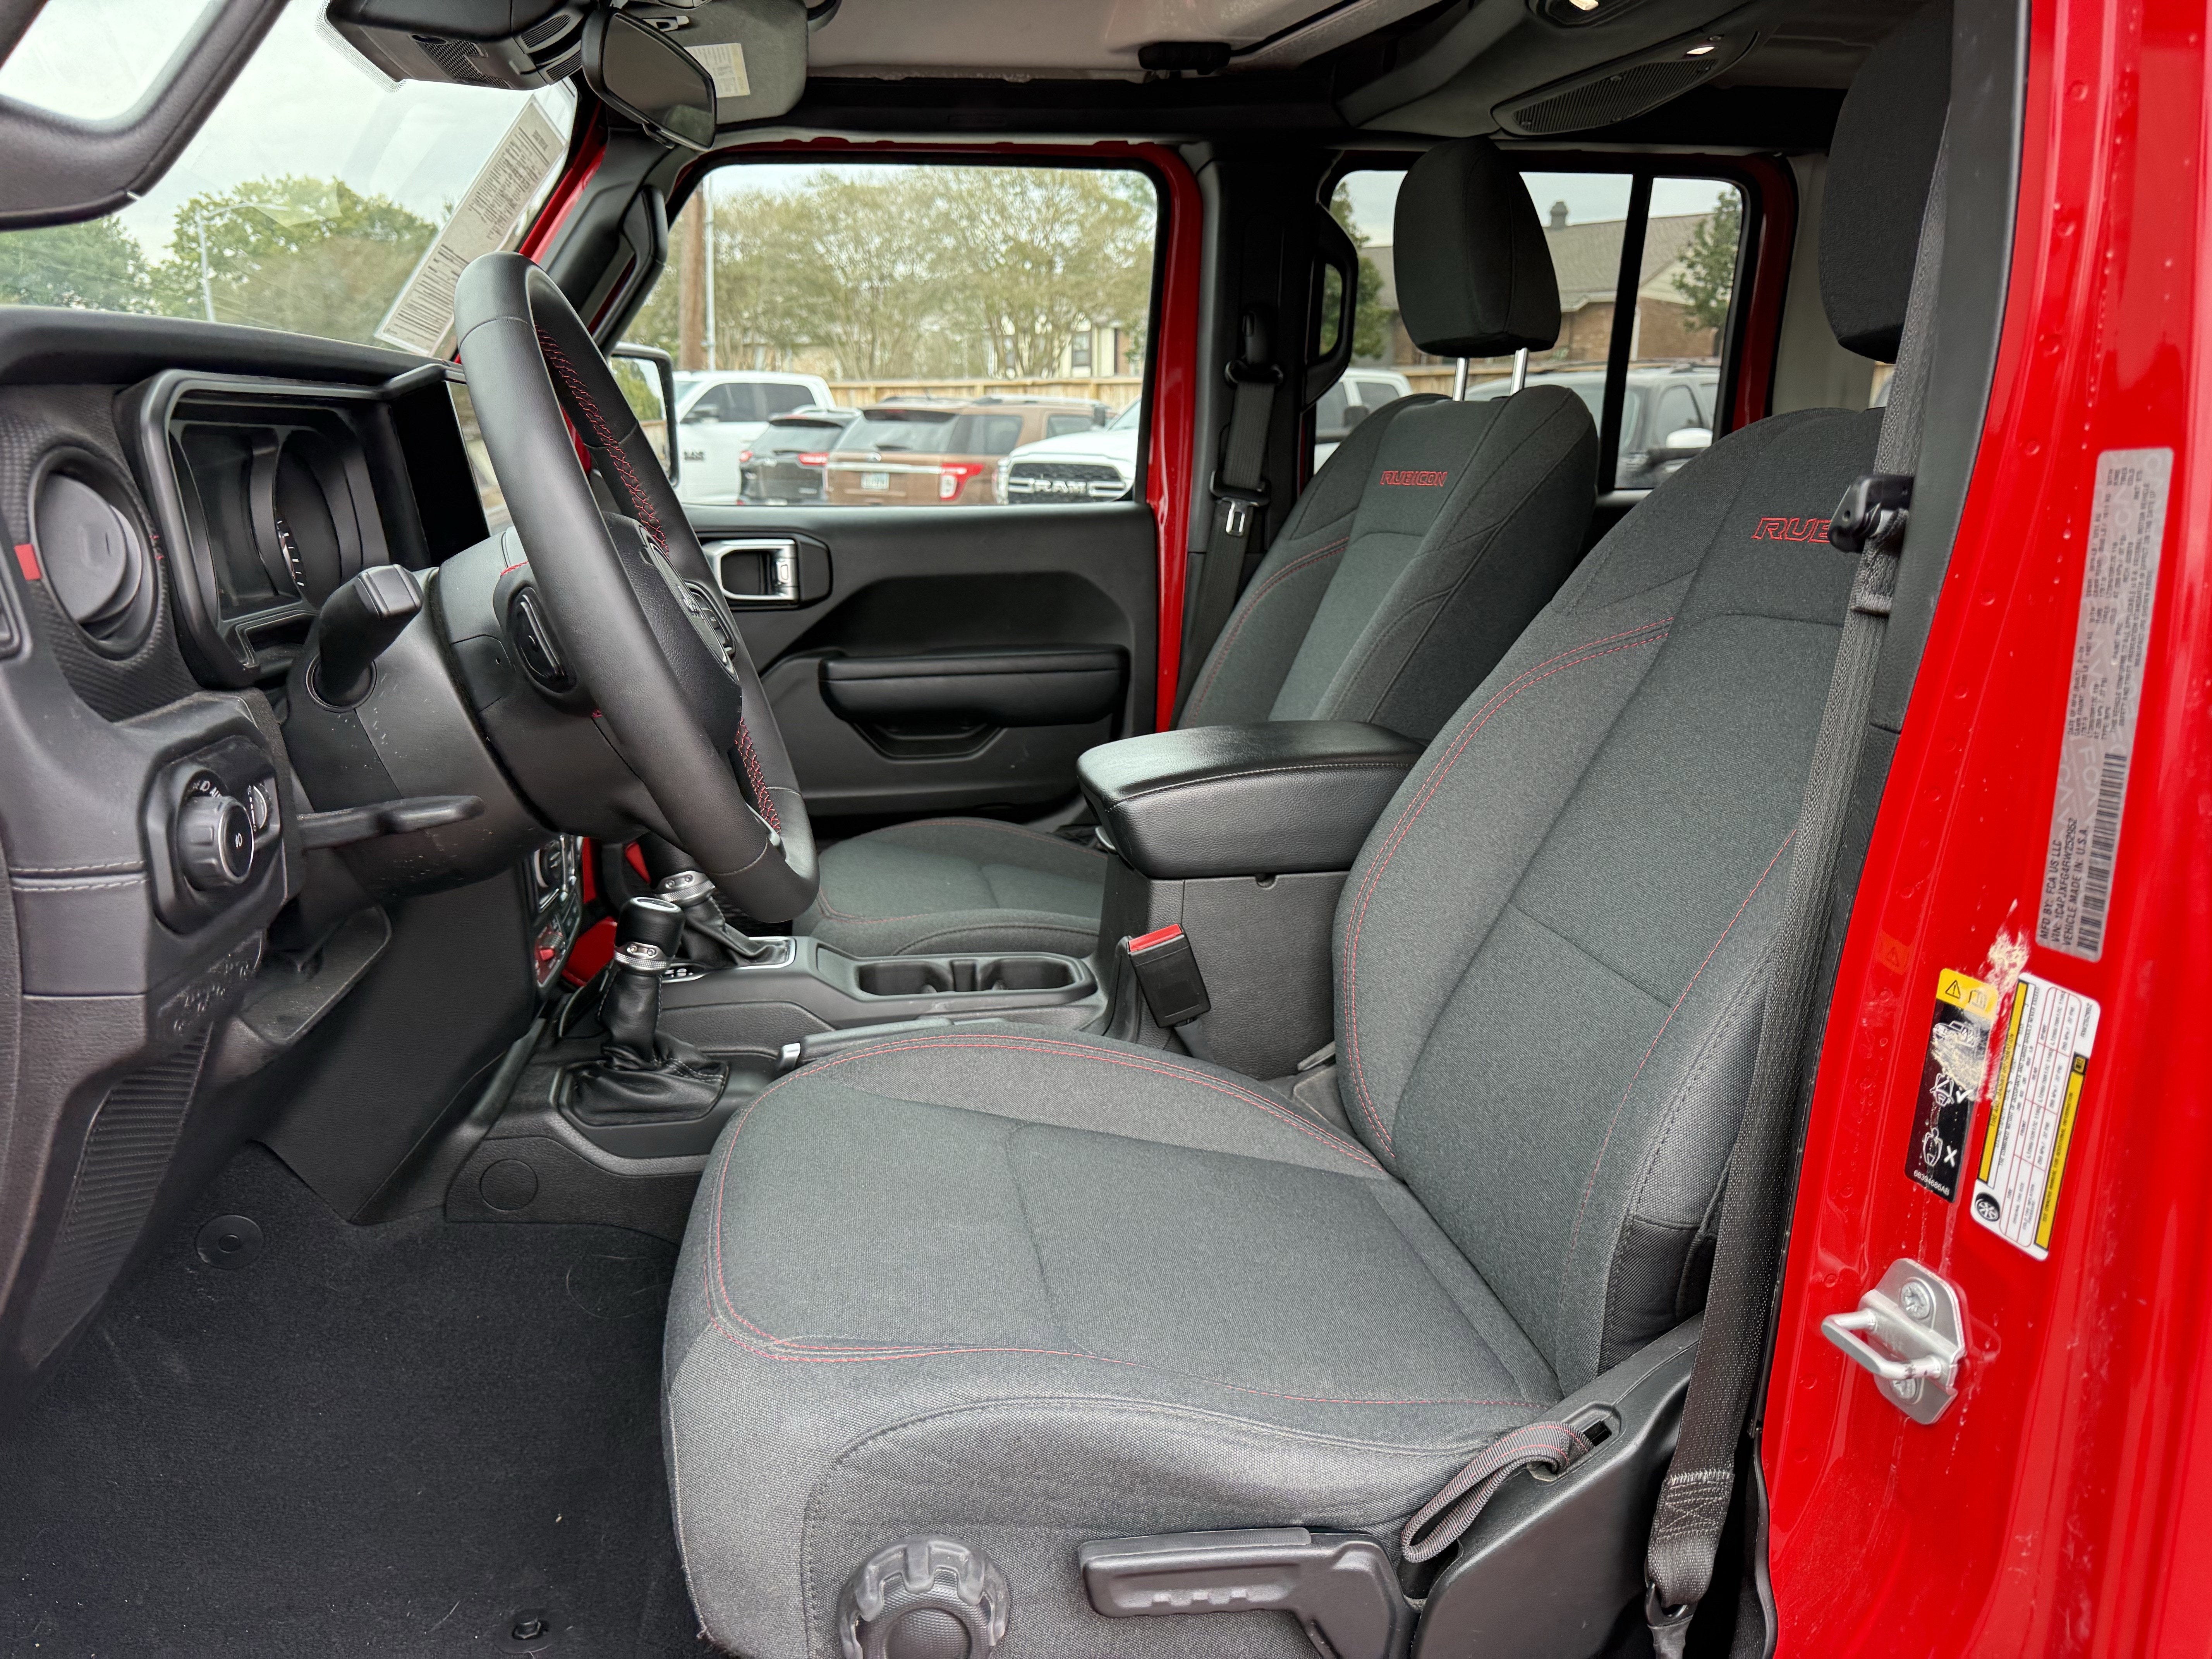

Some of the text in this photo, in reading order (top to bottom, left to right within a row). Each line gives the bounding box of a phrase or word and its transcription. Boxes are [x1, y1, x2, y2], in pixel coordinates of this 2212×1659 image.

[1034, 479, 1087, 494] RAM
[1379, 471, 1448, 487] RUBICON
[2051, 839, 2062, 857] LLC
[2049, 859, 2059, 873] US
[2045, 876, 2057, 895] FCA
[2068, 875, 2081, 904] MADE
[2062, 906, 2077, 946] VEHICLE
